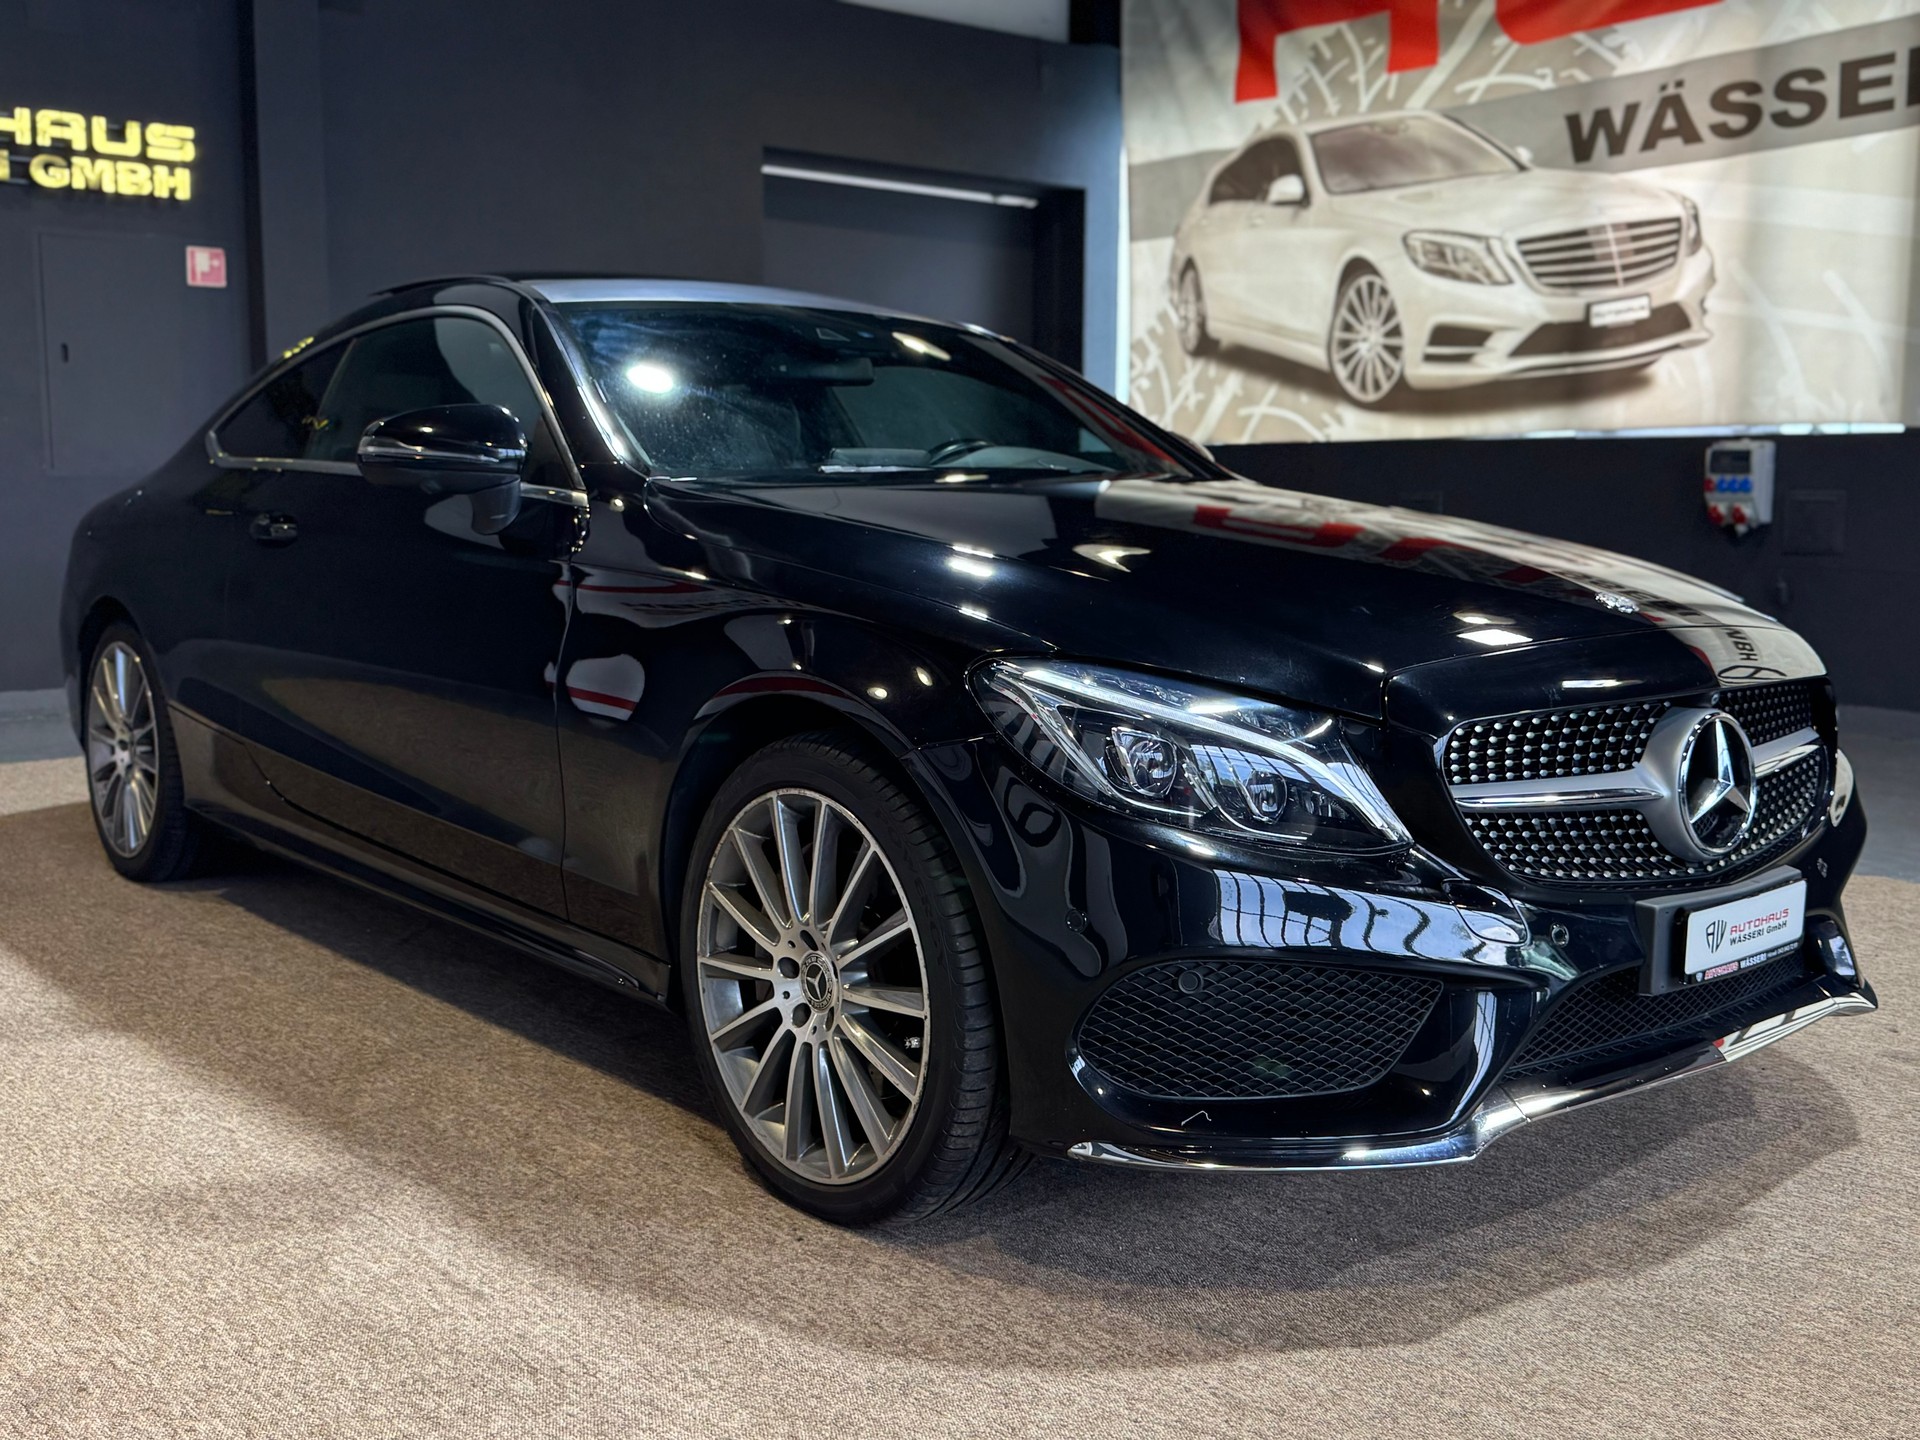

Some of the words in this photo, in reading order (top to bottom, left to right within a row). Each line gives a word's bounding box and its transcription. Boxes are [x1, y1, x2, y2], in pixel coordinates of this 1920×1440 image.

[29, 153, 191, 201] GMBH
[1729, 908, 1789, 936] AUTOHAUS
[1729, 927, 1765, 946] WÄSSERI
[1766, 920, 1788, 934] GmbH
